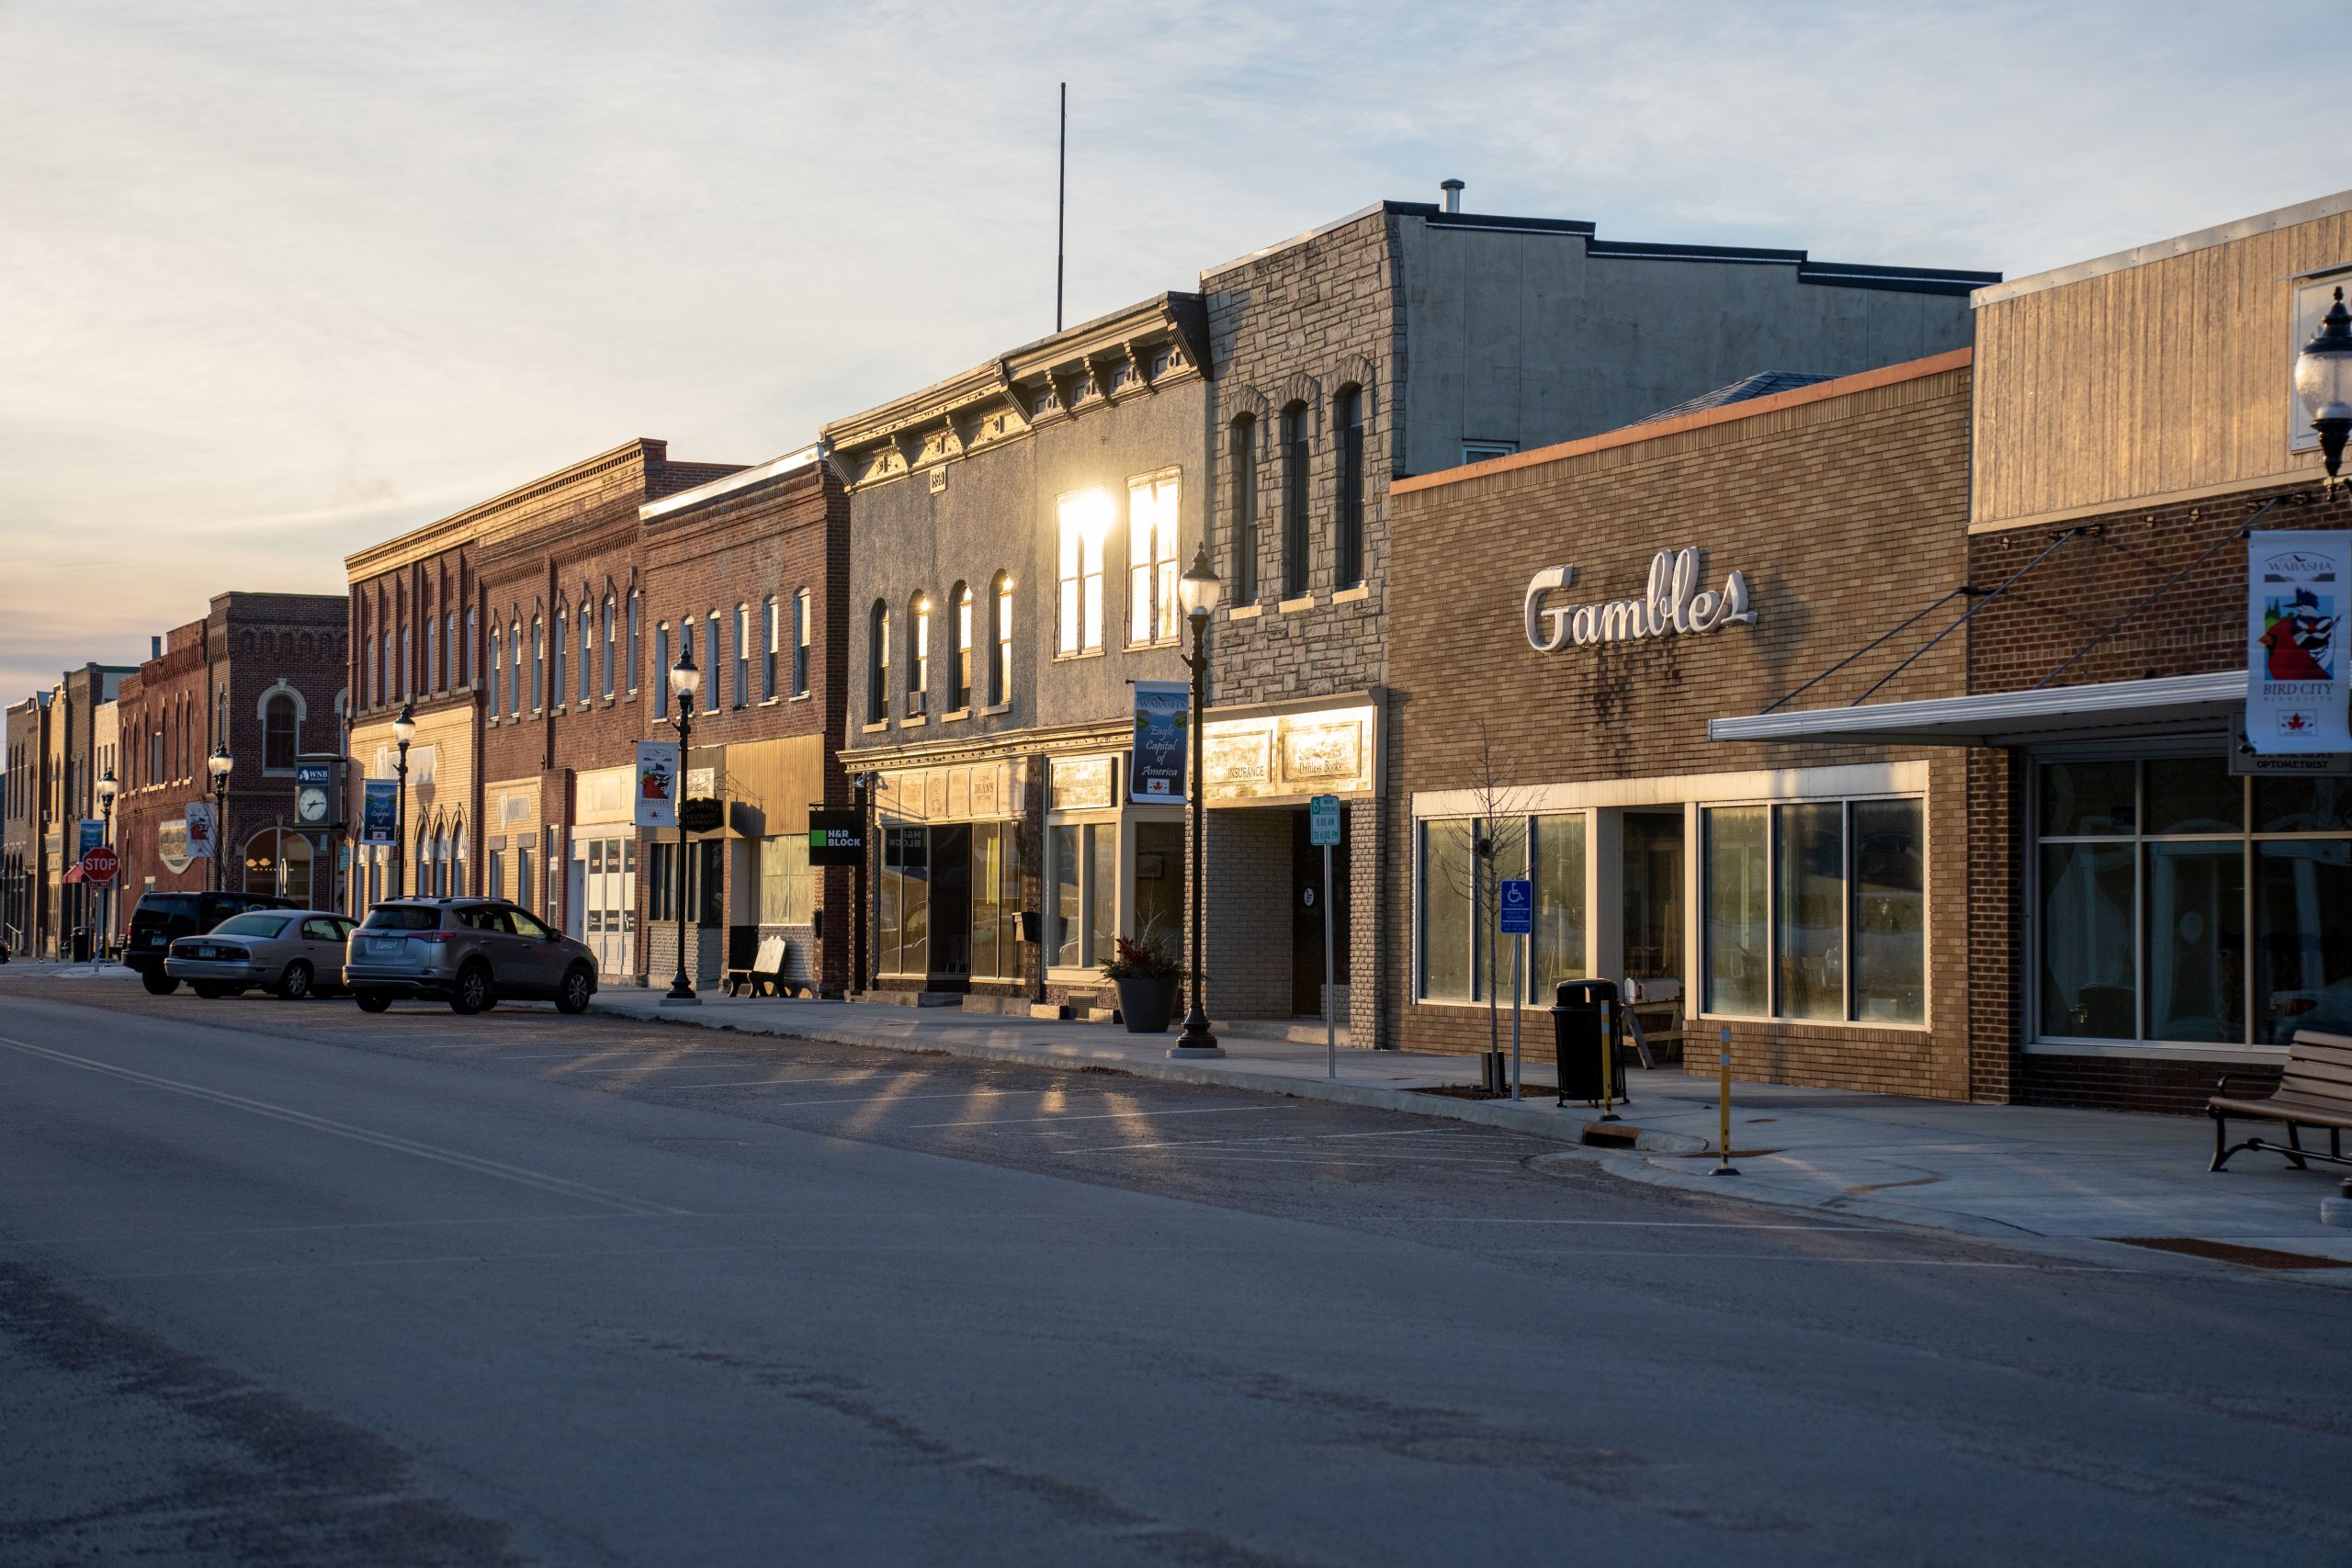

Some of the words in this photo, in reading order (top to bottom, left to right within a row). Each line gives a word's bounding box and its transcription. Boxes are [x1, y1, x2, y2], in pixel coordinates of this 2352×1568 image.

[2267, 561, 2333, 571] WABASHA
[1523, 546, 1758, 654] Gambles
[2263, 682, 2298, 695] BIRD
[2300, 682, 2335, 695] CITY
[1139, 701, 1185, 709] WABASHA
[1149, 724, 1174, 741] Eagle
[1146, 739, 1178, 756] Capital
[1156, 750, 1167, 766] of
[1141, 765, 1178, 777] America
[2256, 760, 2330, 770] OPTOMETRIST
[310, 770, 328, 778] WNB
[1227, 765, 1264, 779] INSURANCE
[974, 782, 994, 795] DEAN'S
[828, 829, 849, 839] H&R
[828, 838, 862, 847] BLOCK
[85, 858, 118, 872] STOP
